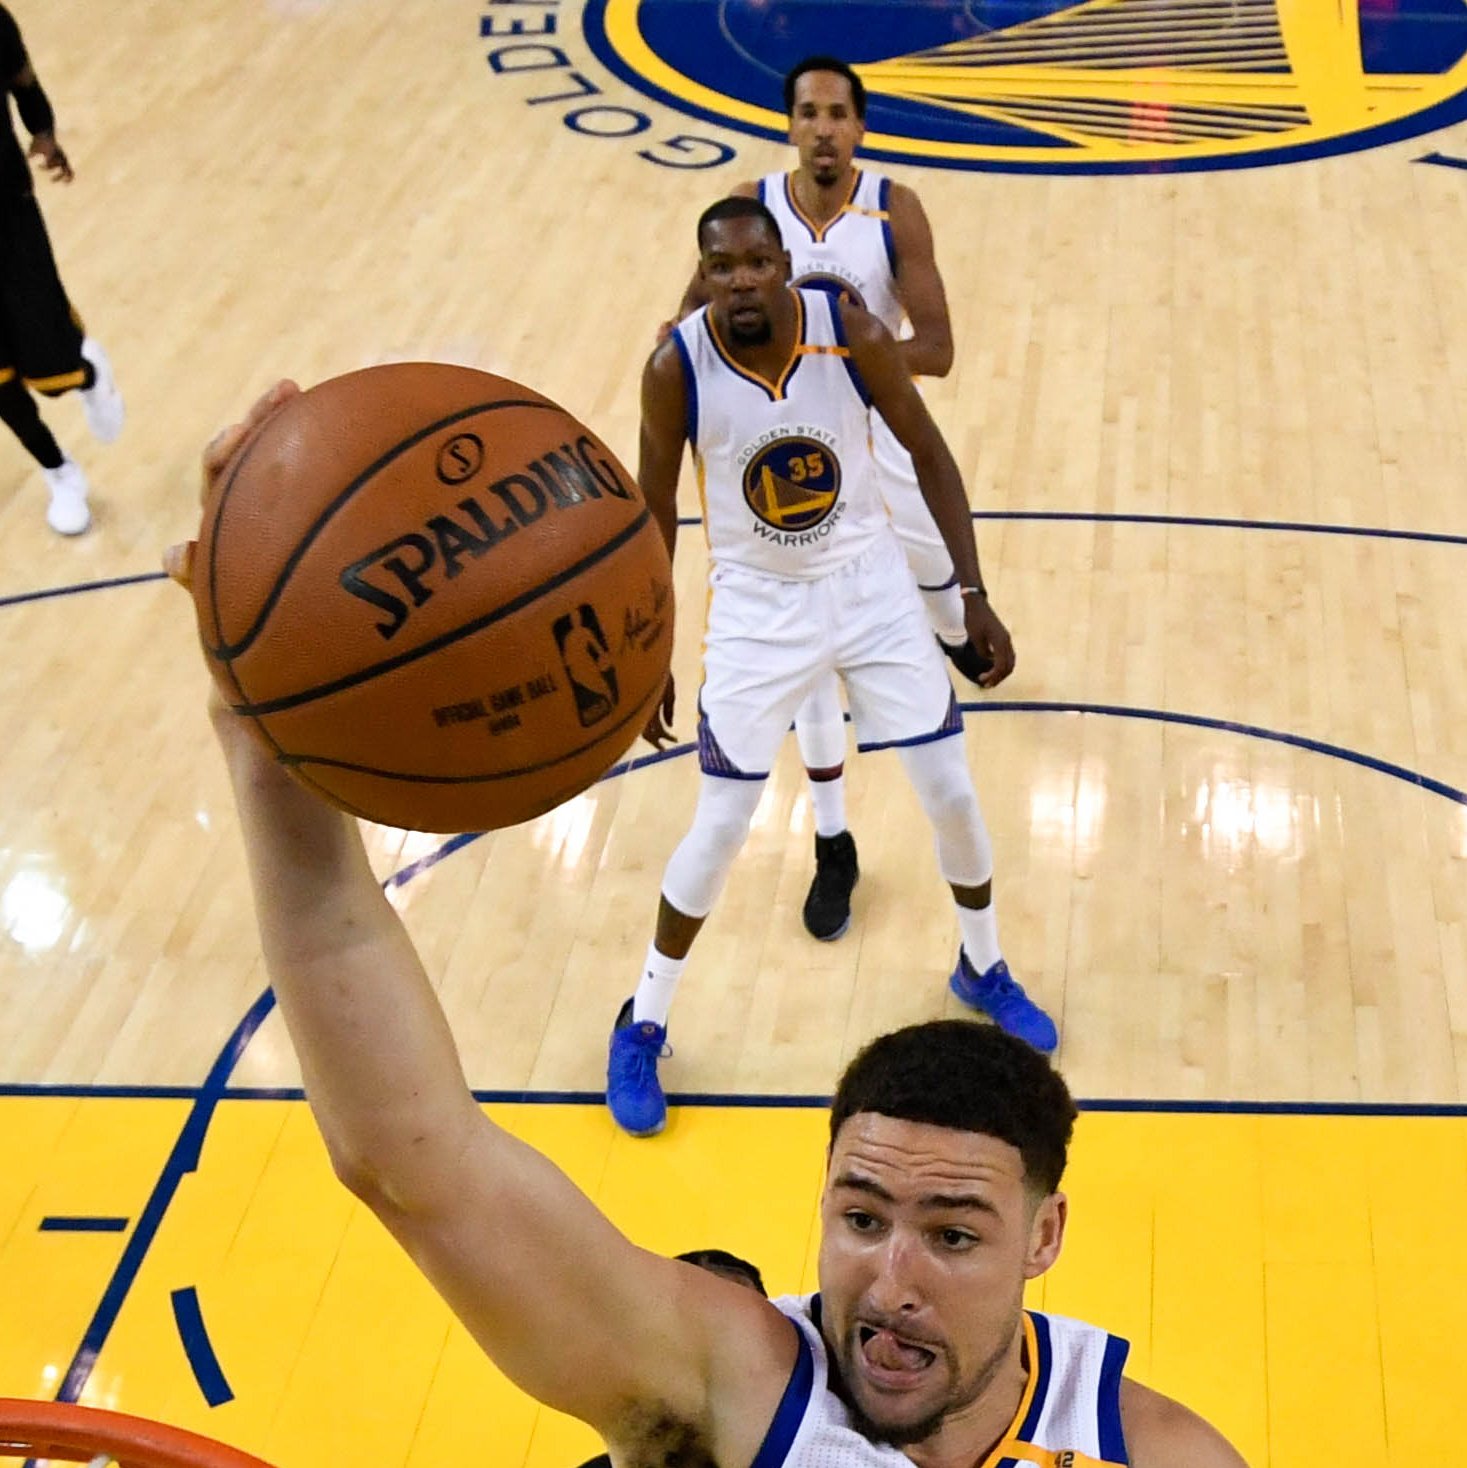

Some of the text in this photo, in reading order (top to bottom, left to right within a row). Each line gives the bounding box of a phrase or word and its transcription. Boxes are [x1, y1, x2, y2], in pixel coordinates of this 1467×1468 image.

[479, 0, 737, 169] GOLDE
[737, 426, 836, 466] GOLDEN STATE
[788, 452, 825, 483] 35
[339, 435, 631, 641] SPALDING
[753, 501, 847, 547] WARRIORS
